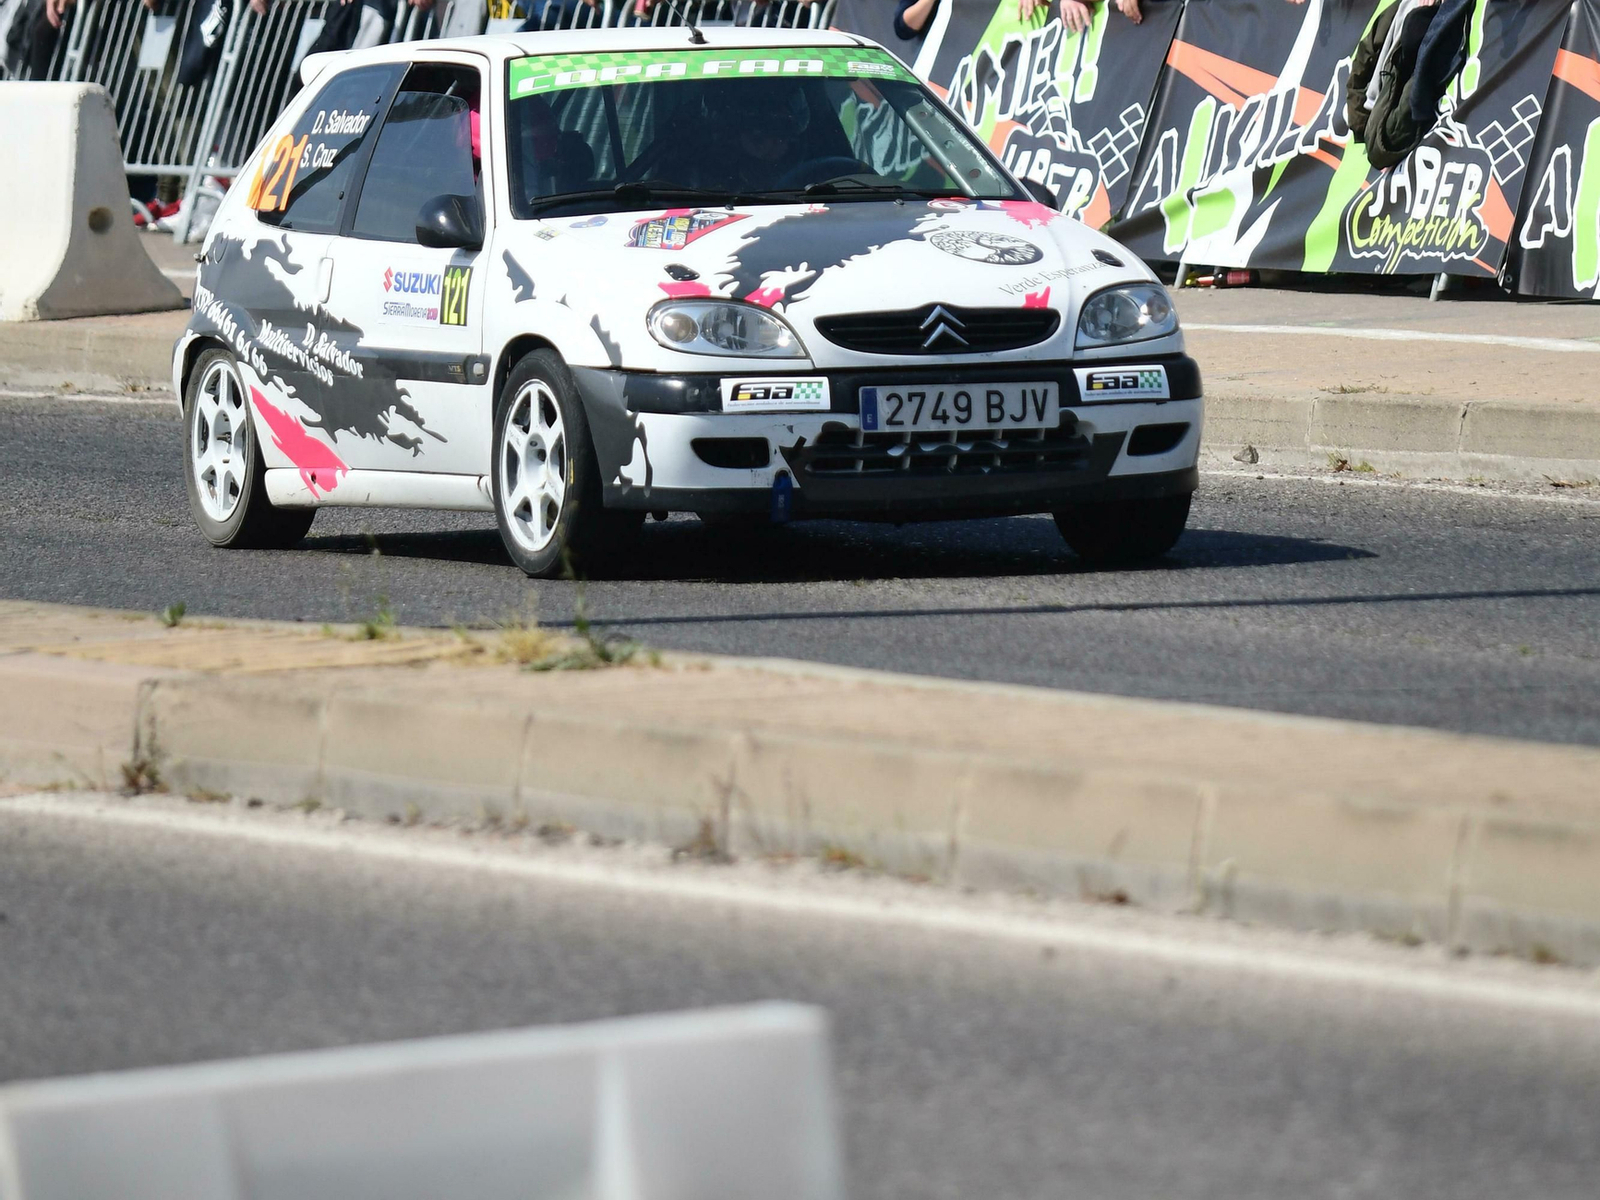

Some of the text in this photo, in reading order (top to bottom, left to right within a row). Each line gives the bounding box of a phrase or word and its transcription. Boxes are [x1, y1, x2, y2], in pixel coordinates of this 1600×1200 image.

[516, 59, 825, 94] COPA FAA
[311, 109, 371, 135] D. Salvador
[246, 134, 309, 212] 121
[300, 142, 338, 169] S. Cruz
[393, 271, 441, 295] SUZUKI
[443, 267, 471, 326] 121
[998, 261, 1108, 297] Verde Esperanza
[235, 329, 252, 363] 64
[251, 346, 268, 377] 66
[256, 318, 334, 387] Multiservicios
[312, 332, 364, 380] Salvador
[866, 413, 873, 423] E
[886, 388, 1049, 426] 2749 BJV
